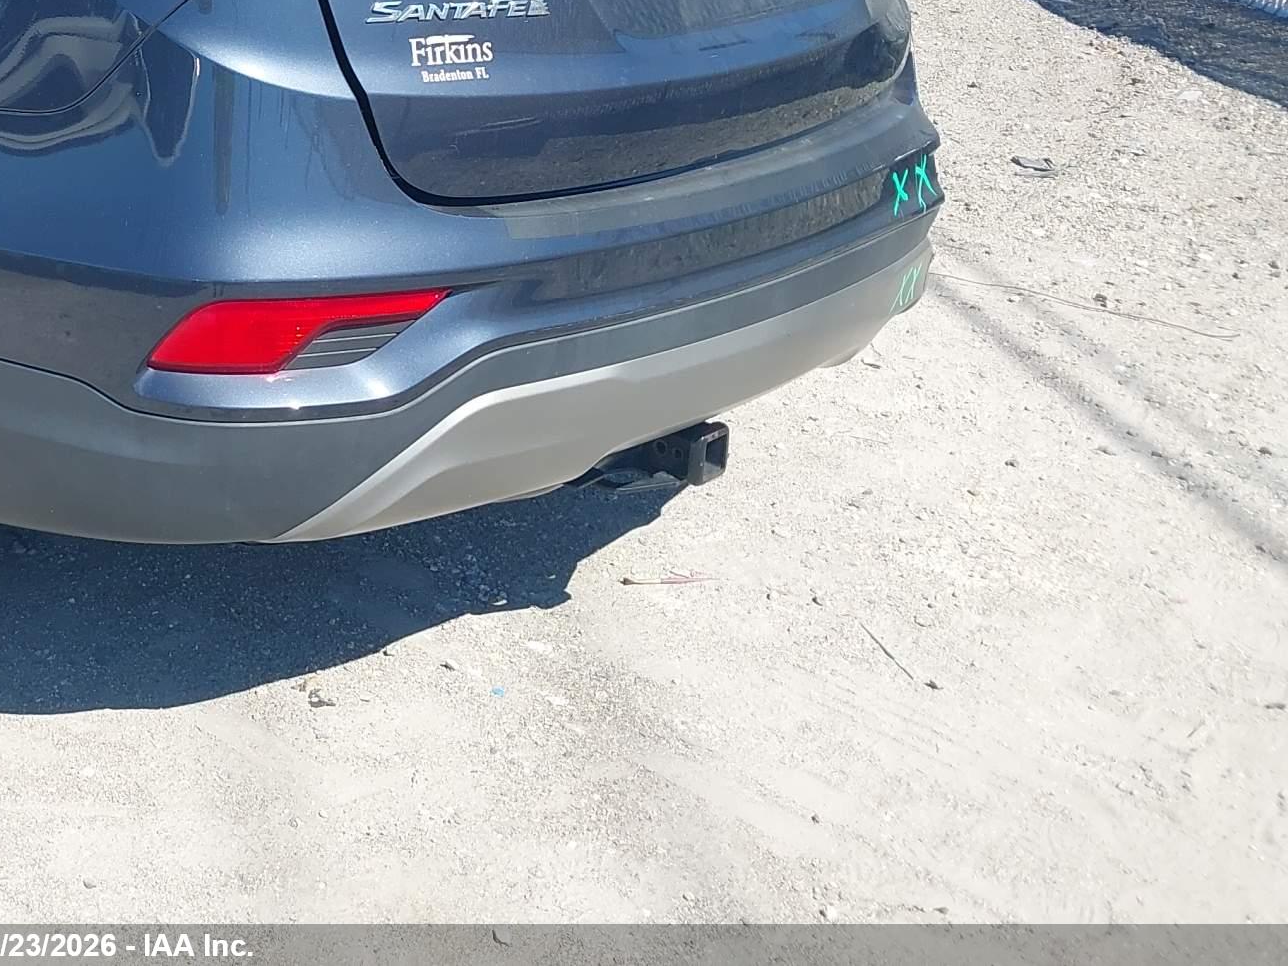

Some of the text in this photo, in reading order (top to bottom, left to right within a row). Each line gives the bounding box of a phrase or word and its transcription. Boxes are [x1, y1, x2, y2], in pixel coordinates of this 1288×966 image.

[408, 34, 494, 68] Firkins
[420, 67, 490, 83] Bradenton FL
